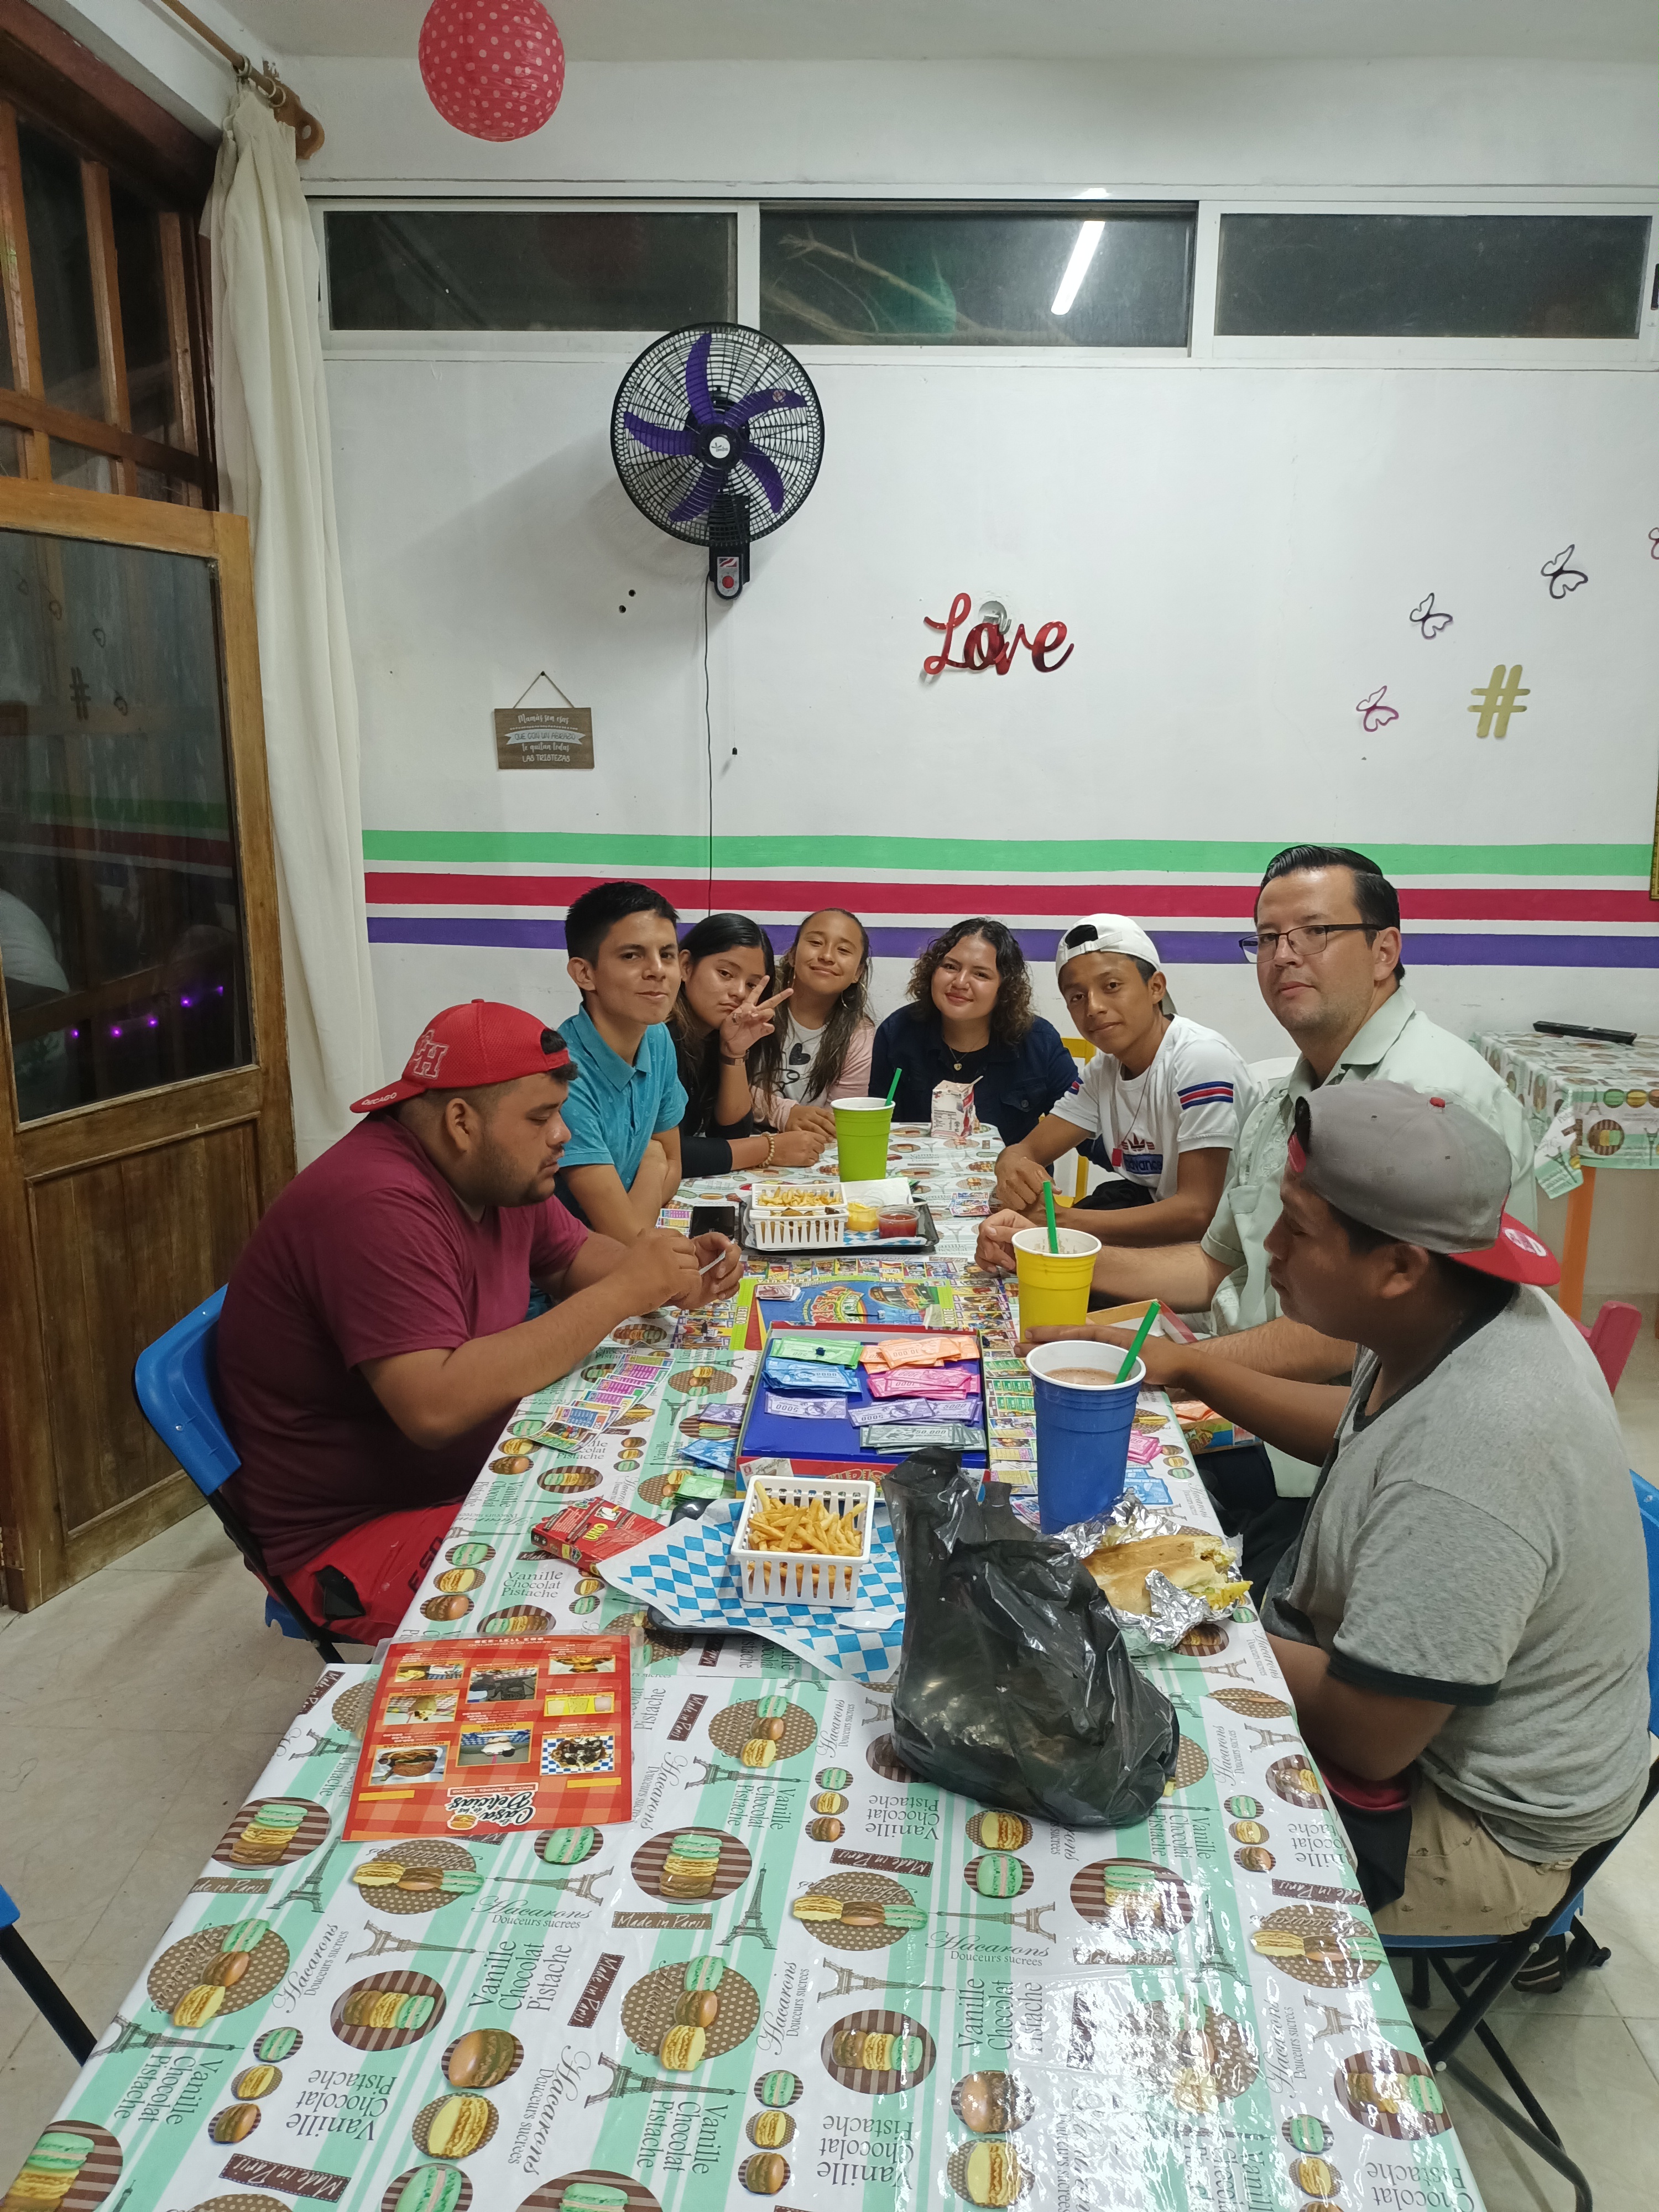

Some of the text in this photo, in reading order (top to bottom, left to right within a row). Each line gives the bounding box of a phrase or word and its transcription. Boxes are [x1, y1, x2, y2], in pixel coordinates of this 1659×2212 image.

[924, 593, 1074, 675] Love
[530, 742, 551, 752] quitan
[553, 742, 570, 752] todas
[361, 1092, 397, 1106] CHICAGO
[776, 1404, 800, 1412] 5000
[654, 1441, 669, 1460] Vanille
[464, 1481, 489, 1507] Pistache
[482, 1481, 502, 1507] Chocolat
[500, 1481, 524, 1507] Vanille
[582, 1524, 608, 1541] UNO
[503, 1580, 561, 1589] Chocolat
[508, 1571, 563, 1579] Vanille
[502, 1588, 558, 1598] Pistache
[634, 1688, 666, 1730] Pistache
[682, 1695, 704, 1713] Made
[815, 1699, 844, 1759] Macarons
[838, 1704, 855, 1747] Douceurs sucrees
[1212, 1725, 1236, 1786] Macarons
[1233, 1751, 1245, 1775] Douceurs
[447, 1792, 532, 1810] Delicias
[641, 1751, 688, 1830] Macarons
[869, 1794, 940, 1811] Pistache
[478, 1807, 533, 1824] Casa
[728, 1785, 755, 1827] Pistache
[749, 1786, 775, 1828] Chocolat
[769, 1788, 796, 1830] Vanille
[867, 1808, 940, 1825] Chocolat
[865, 1823, 940, 1840] Vanille
[1149, 1815, 1166, 1856] Pistache
[1192, 1817, 1216, 1859] Vanille
[1287, 1824, 1337, 1837] tache
[1291, 1838, 1343, 1851] ocolat
[840, 1849, 870, 1866] Paris
[890, 1858, 927, 1874] Made
[1295, 1853, 1346, 1867] nille
[215, 1881, 227, 1891] in
[231, 1880, 264, 1892] Paris
[1279, 1881, 1312, 1898] Paris
[471, 1896, 592, 1919] Macarons
[492, 1914, 581, 1929] Douceurs sucrees
[617, 1914, 706, 1929] Made in Paris
[925, 1931, 1048, 1957] Macarons
[272, 1923, 338, 2013] Macarons
[306, 1929, 349, 1997] Douceurs sucrees
[591, 1957, 618, 1984] Made
[950, 1950, 1042, 1966] Douceurs sucrees
[468, 1940, 517, 2007] Vanille
[498, 1943, 544, 2010] Chocolat
[526, 1944, 572, 2011] Pistache
[577, 1997, 600, 2023] Paris
[757, 1961, 797, 2056] Macarons
[785, 1969, 810, 2037] Douceurs sucrees
[958, 1978, 985, 2048] Vanille
[985, 1980, 1013, 2050] Chocolat
[1285, 2007, 1307, 2080] Douceurs sucrees
[113, 2054, 173, 2119] Pistache
[138, 2056, 197, 2123] Chocolat
[166, 2060, 224, 2125] Vanille
[307, 2069, 398, 2095] Pistache
[298, 2090, 388, 2117] Chocolat
[508, 2069, 556, 2164] Douceurs sucrees
[524, 2045, 591, 2176] Macarons
[285, 2113, 375, 2141] Vanille
[637, 2099, 671, 2168] Pistache
[663, 2102, 701, 2172] Chocolat
[692, 2105, 728, 2174] Vanille
[823, 2115, 913, 2139] Pistache
[819, 2137, 914, 2164] Chocolat
[233, 2158, 277, 2184] Paris
[297, 2171, 343, 2197] Made
[817, 2162, 913, 2189] Vanille
[1365, 2162, 1467, 2189] Pistache
